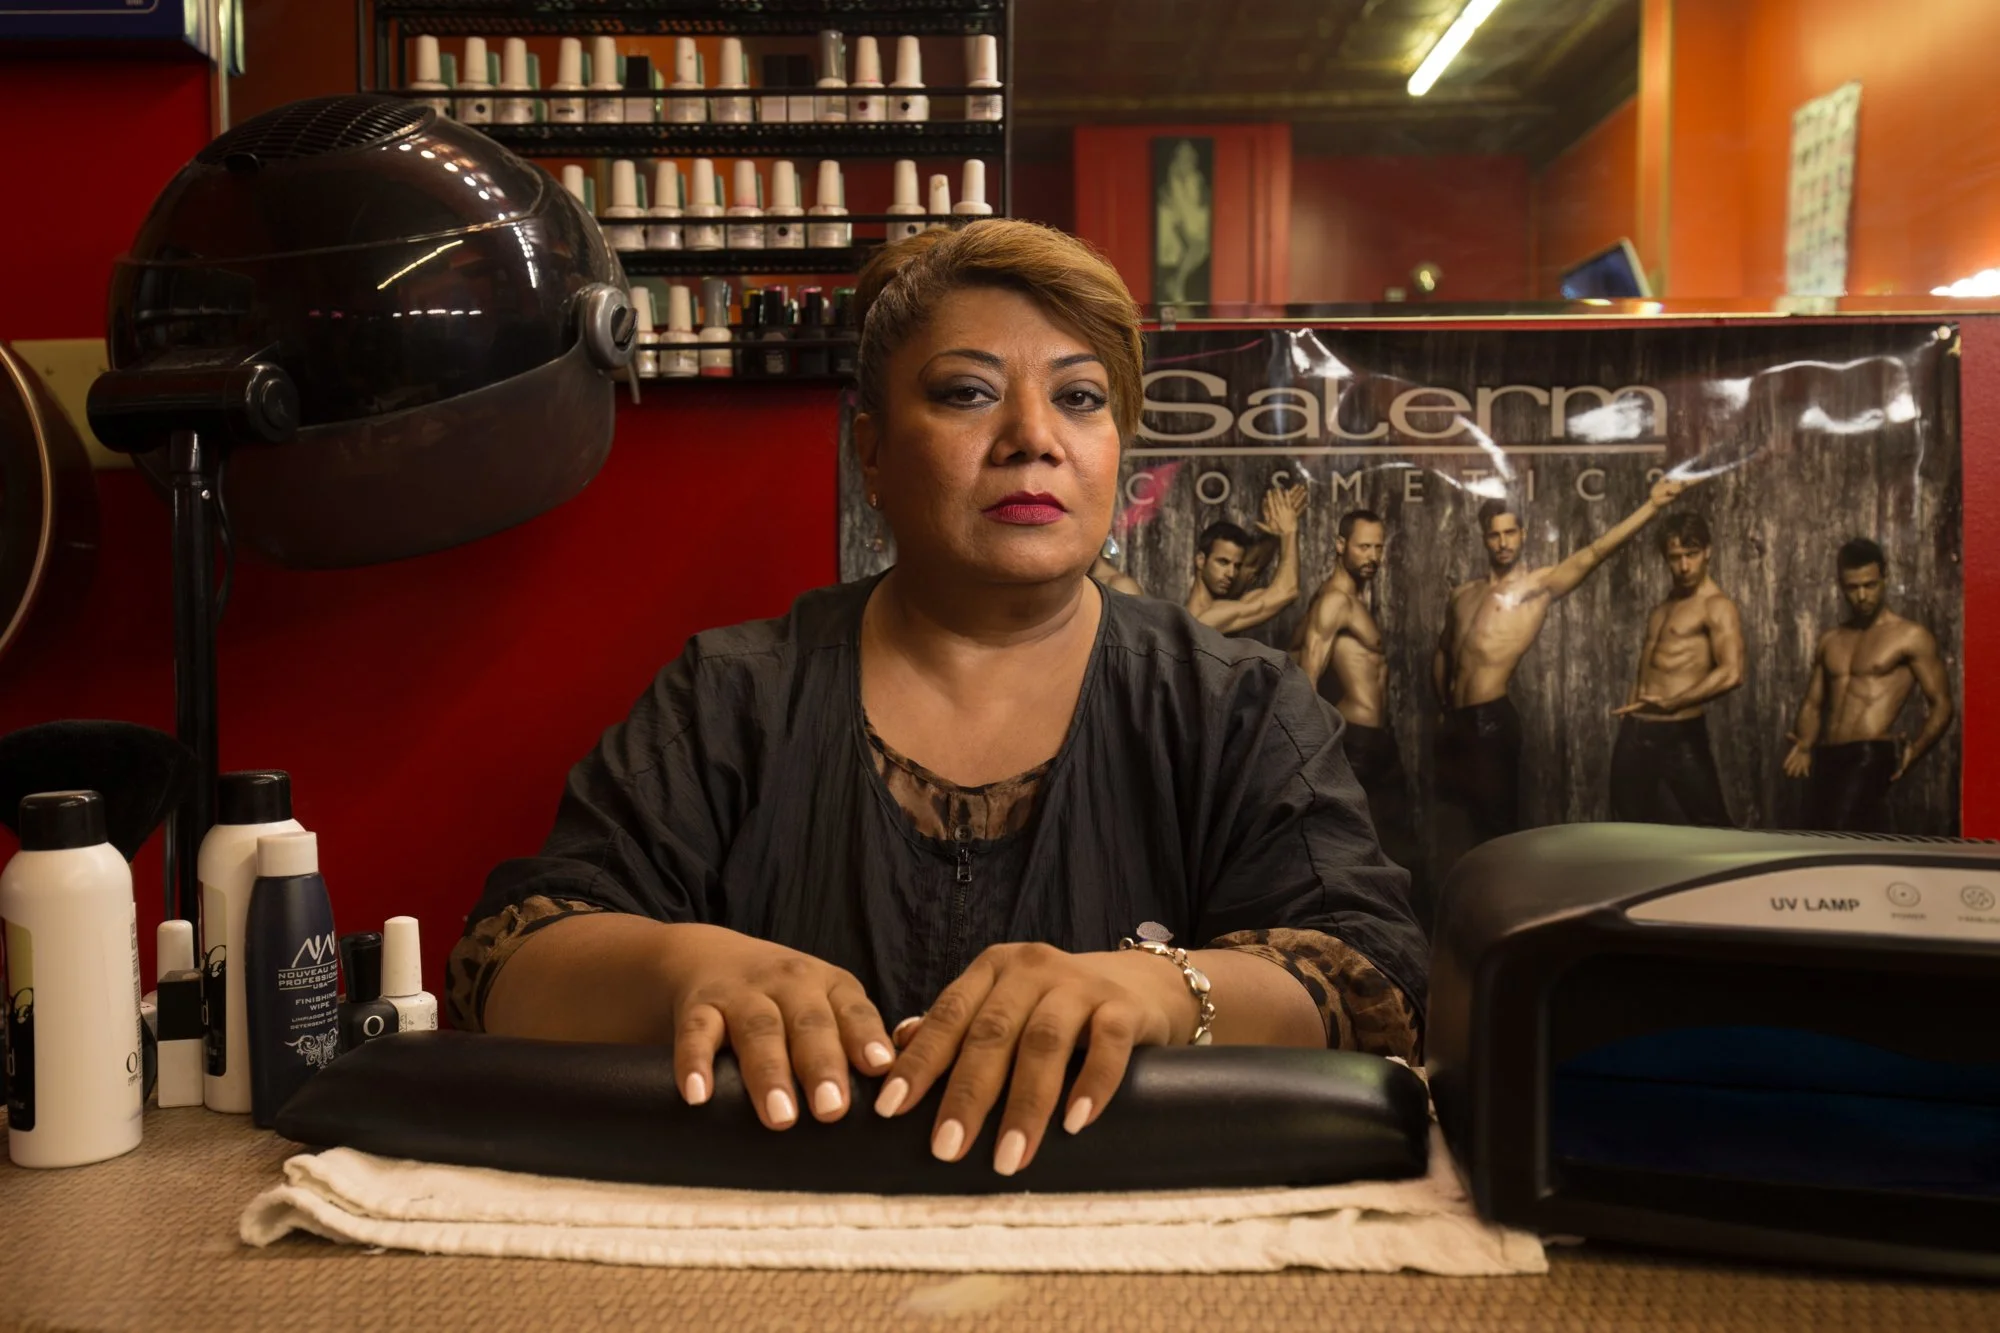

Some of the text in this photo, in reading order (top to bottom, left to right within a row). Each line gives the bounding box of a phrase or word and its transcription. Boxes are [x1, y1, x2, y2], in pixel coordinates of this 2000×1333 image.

[1770, 898, 1860, 912] UV LAMP
[278, 966, 329, 979] NOUVEAU
[313, 982, 328, 990] USA
[310, 1001, 330, 1011] WIPE
